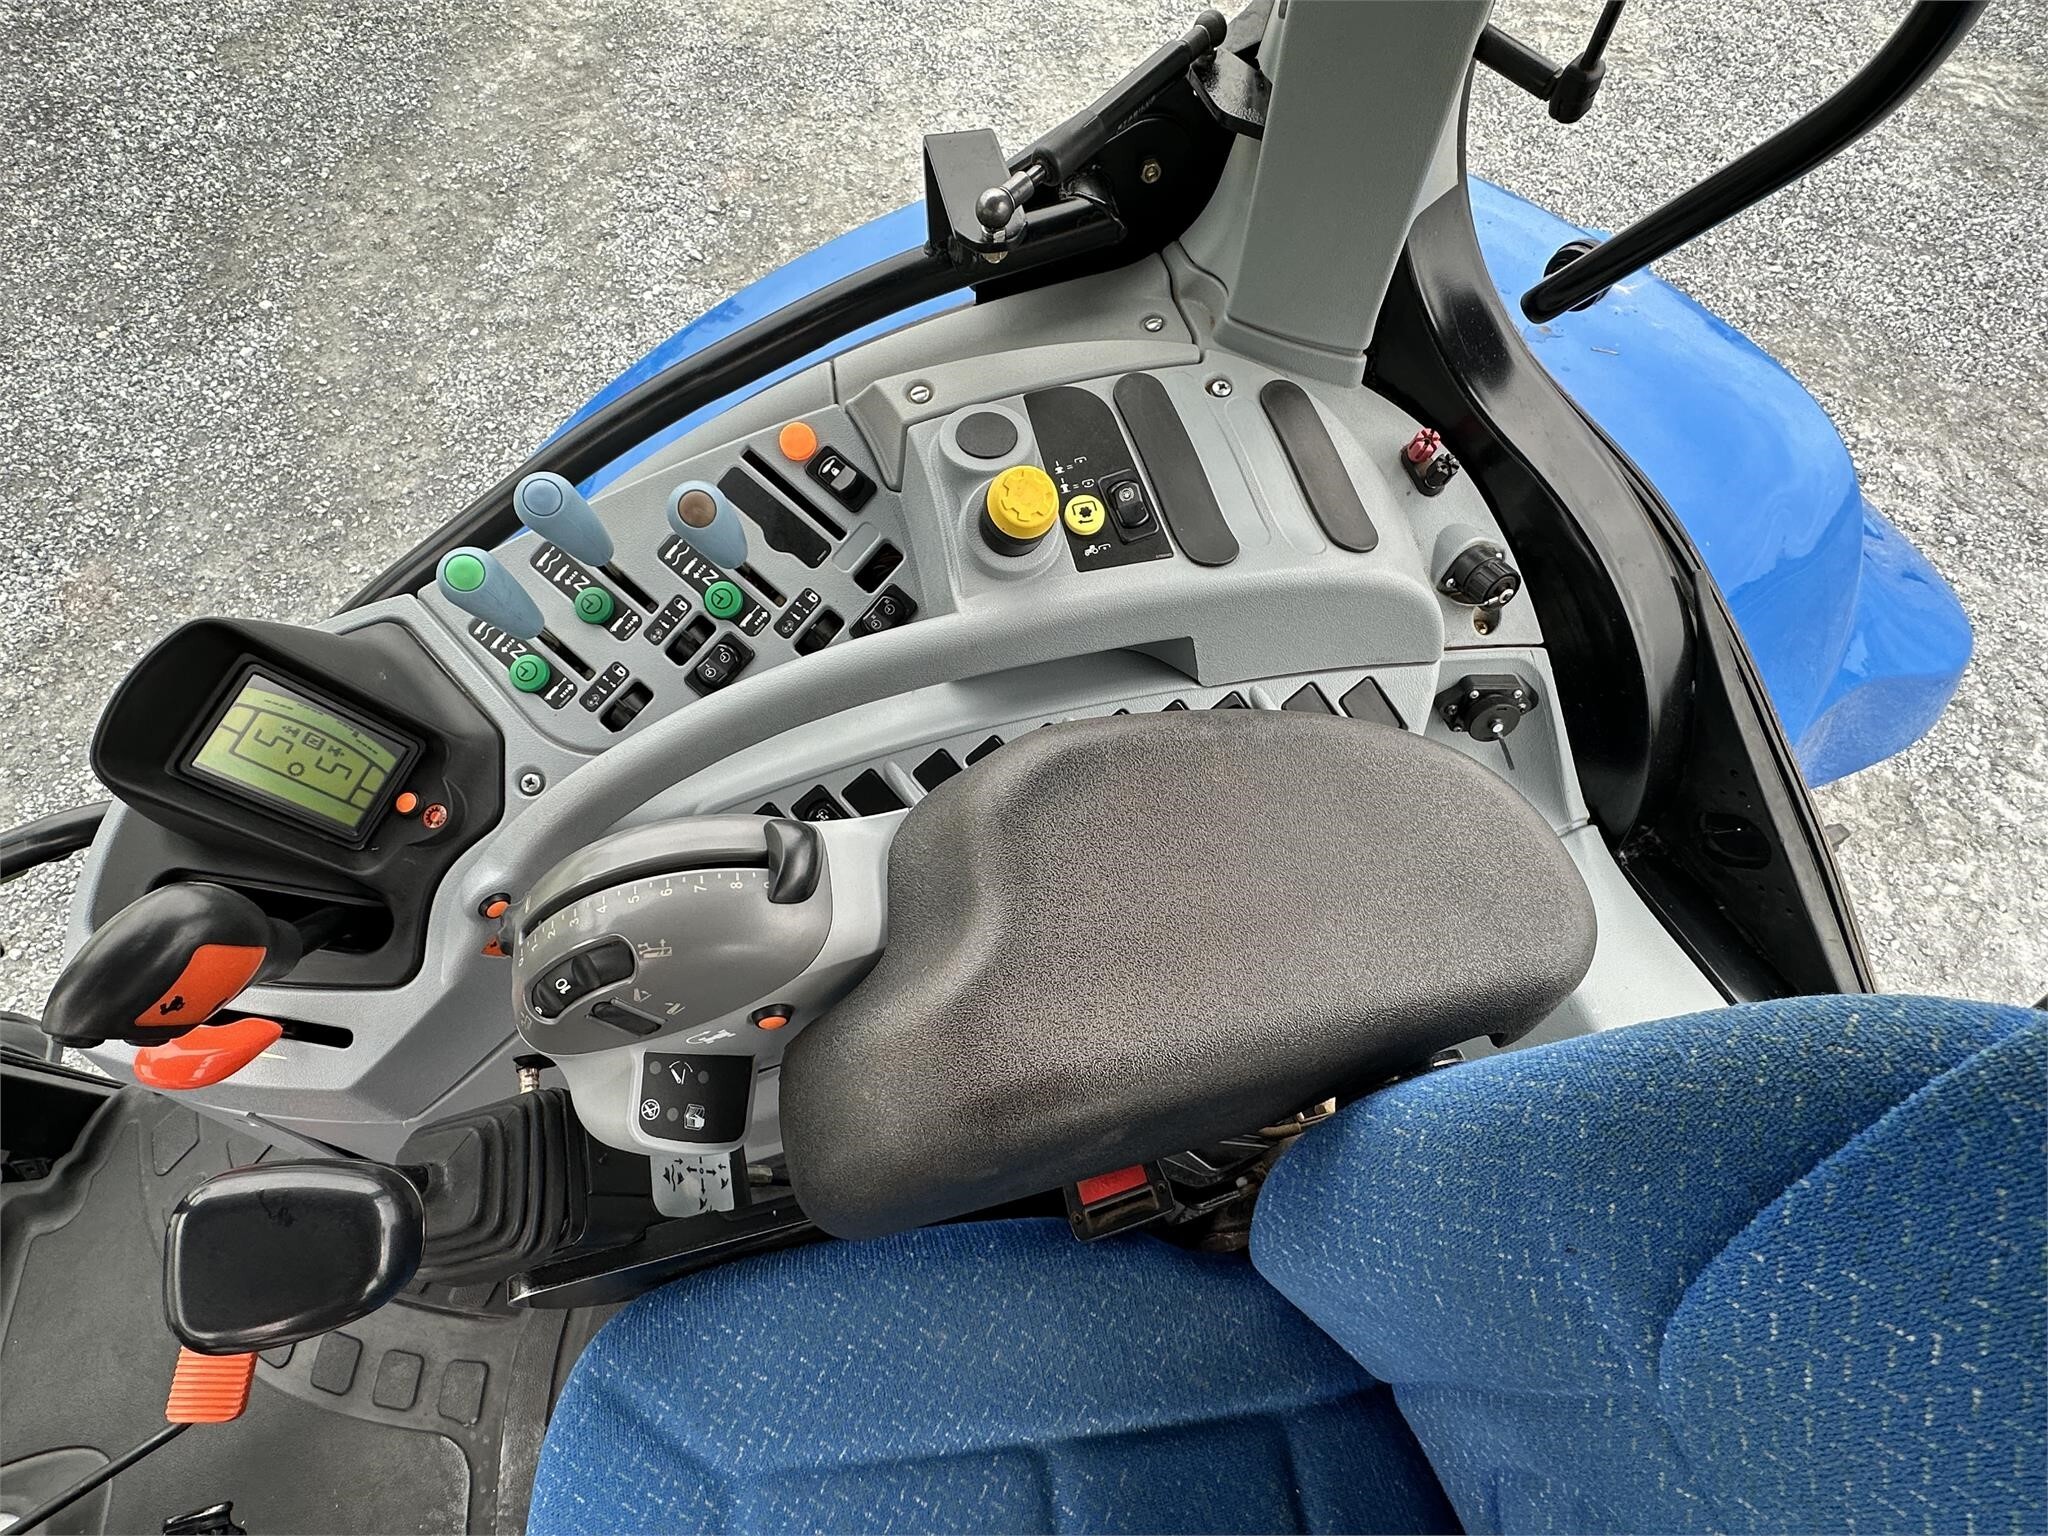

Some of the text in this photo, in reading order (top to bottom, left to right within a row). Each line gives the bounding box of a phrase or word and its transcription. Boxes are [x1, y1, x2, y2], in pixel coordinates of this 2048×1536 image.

[547, 929, 556, 938] 2
[569, 917, 579, 927] 3
[595, 905, 607, 913] 4
[628, 895, 640, 903] 5
[660, 888, 672, 896] 6
[694, 885, 707, 893] 7
[555, 978, 571, 994] 10
